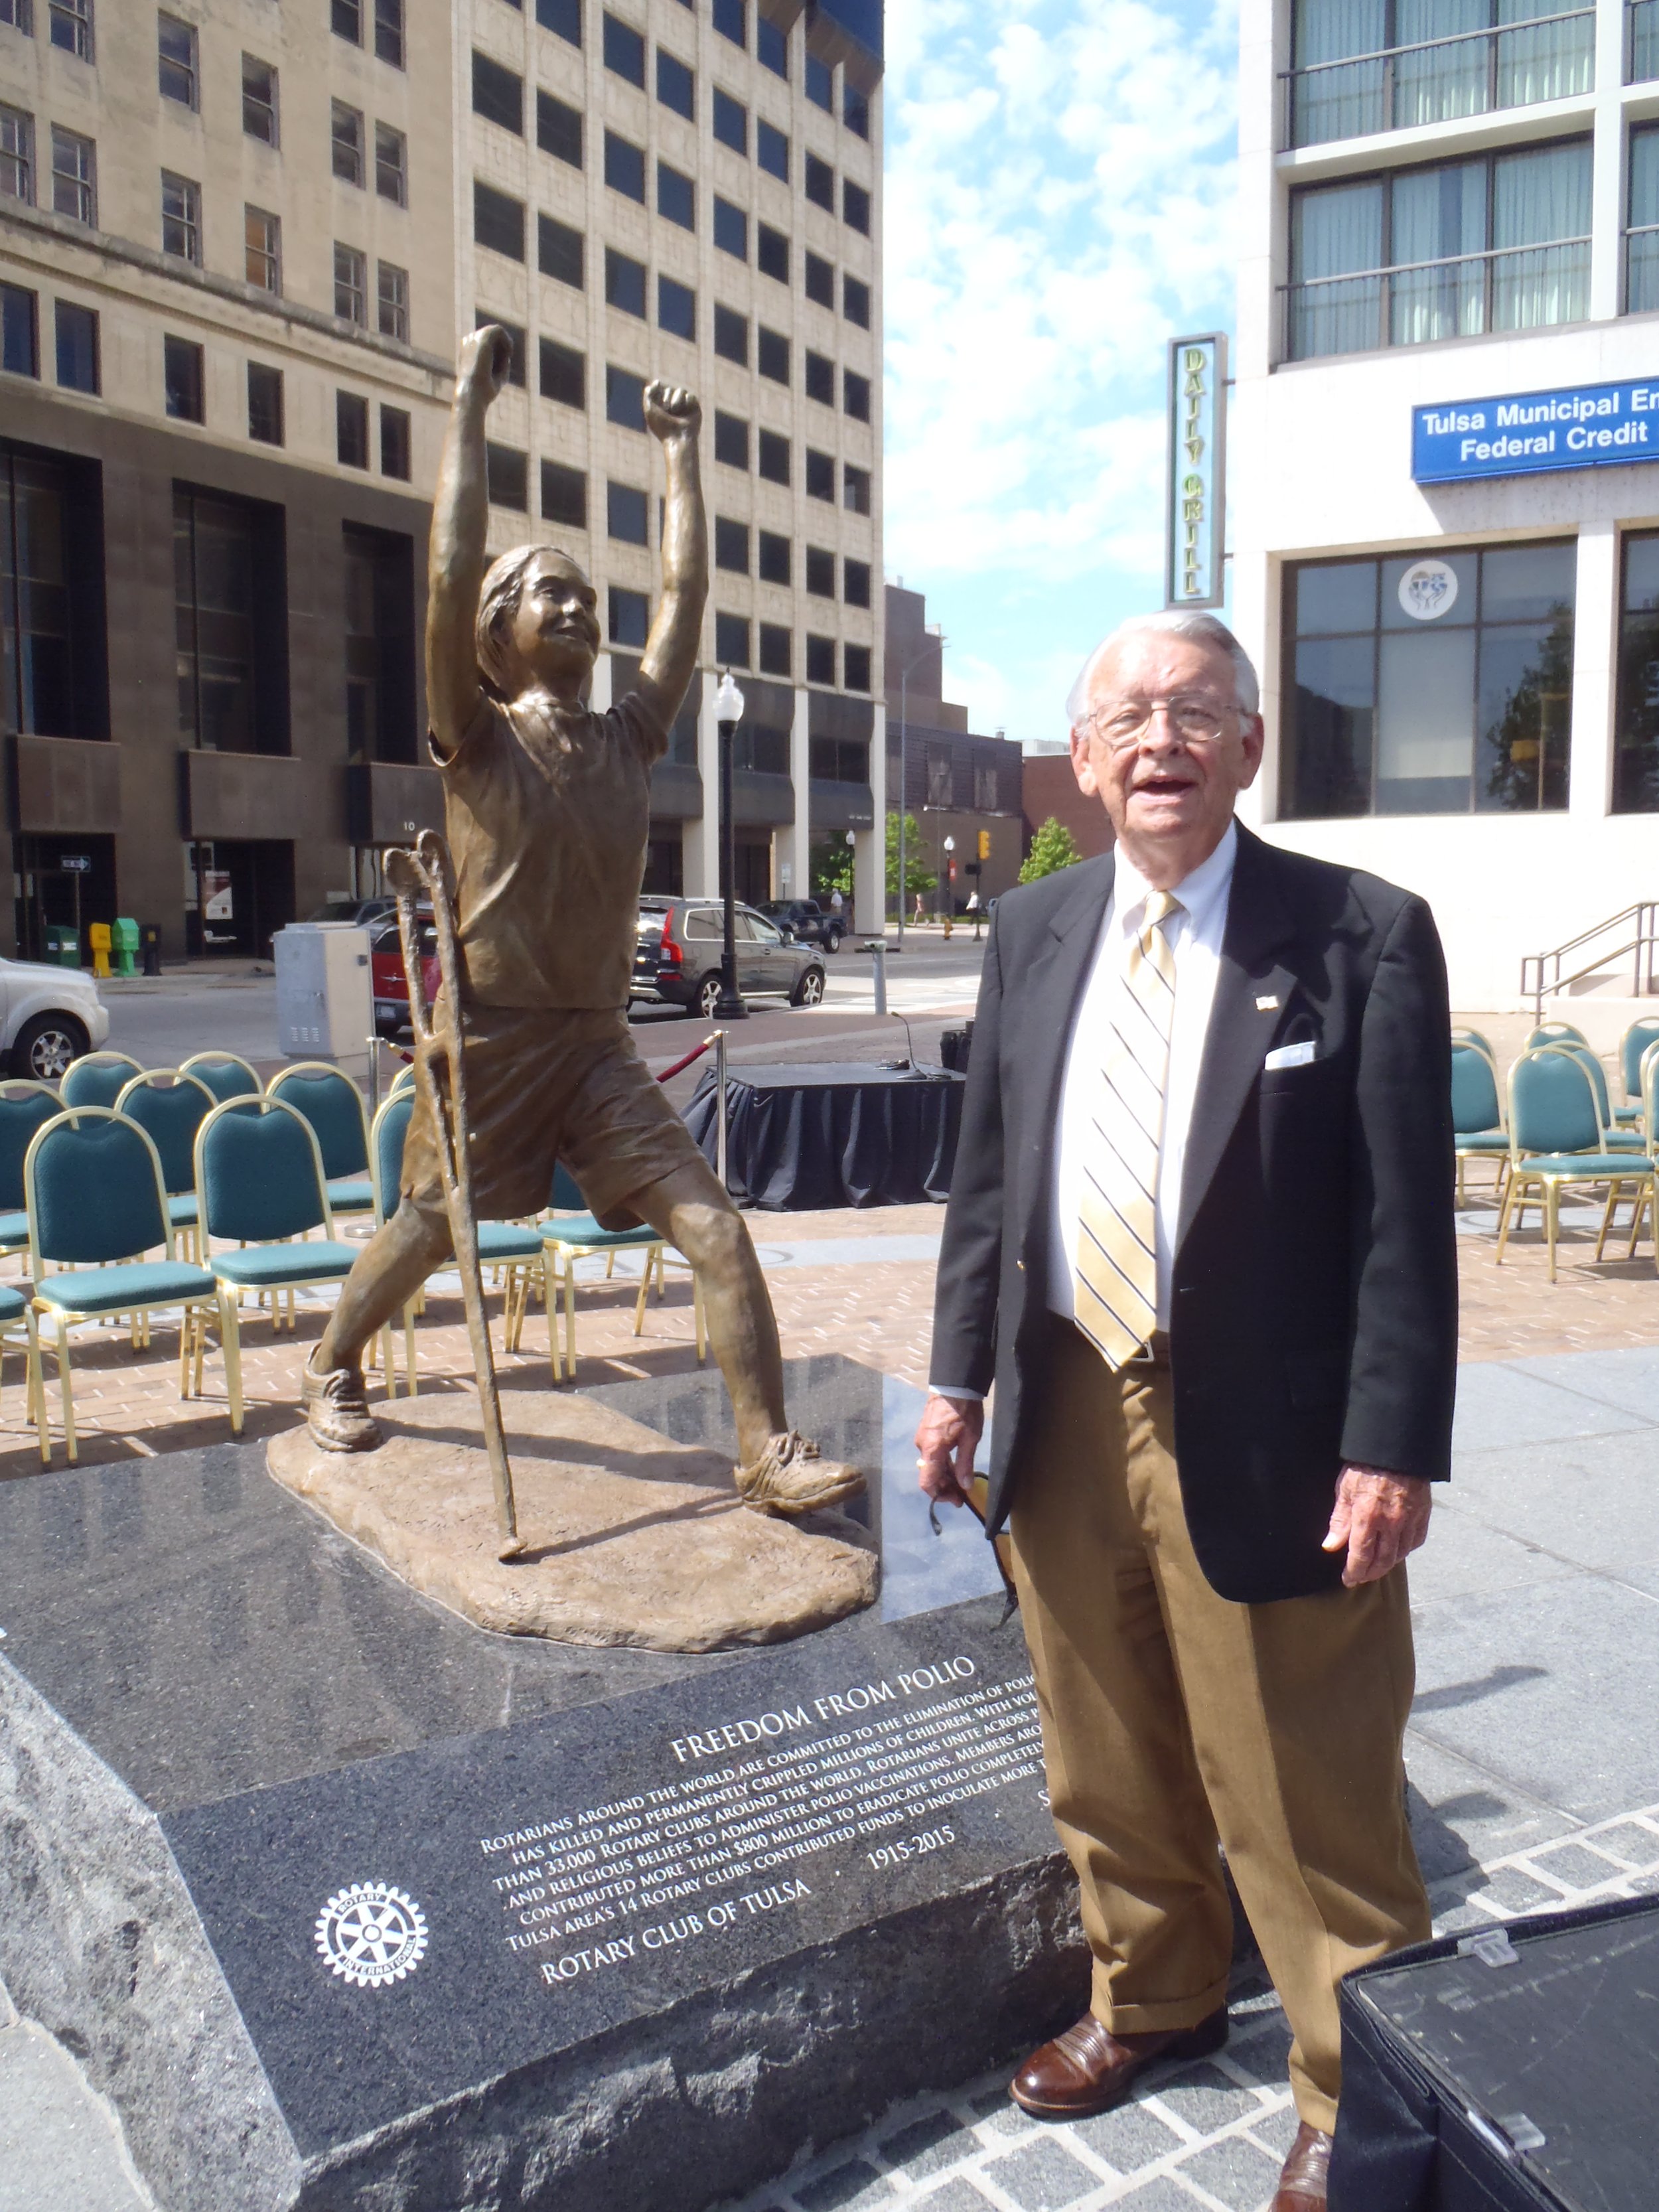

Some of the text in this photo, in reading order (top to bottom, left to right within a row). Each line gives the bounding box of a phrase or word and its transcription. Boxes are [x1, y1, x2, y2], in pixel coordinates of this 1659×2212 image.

[1184, 348, 1206, 465] DAILY
[1422, 411, 1486, 435] Tulsa
[1496, 392, 1619, 427] Municipal
[1461, 421, 1648, 461] Federal Credit
[1183, 473, 1202, 595] GRILL
[480, 1816, 573, 1854] ROTARIANS
[578, 1796, 645, 1826] AROUND
[645, 1785, 679, 1804] THE
[680, 1769, 735, 1794] WORLD
[739, 1759, 766, 1777] ARE
[766, 1733, 851, 1767] COMMITTED
[851, 1726, 873, 1740] TO
[873, 1717, 902, 1733] THE
[902, 1690, 986, 1725] ELIMINATION
[986, 1684, 1003, 1698] OF
[669, 1657, 976, 1763] FREEDOM FROM POLIO
[492, 1866, 542, 1891] THAN
[599, 1829, 661, 1858] ROTARY
[664, 1814, 712, 1838] CLUBS
[715, 1794, 778, 1823] AROUND
[778, 1783, 810, 1801] THE
[866, 1740, 941, 1773] ROTARIANS
[942, 1728, 982, 1747] UNITE
[983, 1712, 1031, 1735] ACROSS
[510, 1887, 545, 1909] AND
[548, 1858, 634, 1895] RELIGIOUS
[636, 1840, 693, 1868] BELIEFS
[693, 1832, 717, 1848] TO
[721, 1803, 811, 1842] ADMINISTER
[810, 1789, 853, 1810] POLIO
[955, 1734, 1015, 1762] MEMBERS
[512, 1845, 545, 1866] HAS
[548, 1828, 603, 1854] KILLED
[608, 1816, 642, 1837] AND
[644, 1782, 749, 1825] PERMANENTLY
[751, 1762, 818, 1791] CRIPPLED
[820, 1741, 885, 1770] MILLIONS
[885, 1733, 903, 1748] OF
[974, 1699, 1013, 1718] WITH
[520, 1879, 636, 1925] CONTRIBUTED
[640, 1862, 685, 1887] MORE
[685, 1847, 732, 1871] THAN
[733, 1834, 768, 1856] $800
[770, 1814, 833, 1844] MILLION
[832, 1807, 855, 1822] TO
[856, 1783, 929, 1814] ERADICATE
[929, 1768, 970, 1790] POLIO
[337, 1893, 382, 1913] ROTARY
[504, 1925, 561, 1951] TULSA
[618, 1897, 638, 1915] 14
[640, 1877, 701, 1908] ROTARY
[705, 1861, 752, 1885] CLUBS
[754, 1826, 855, 1870] CONTRIBUTED
[857, 1808, 904, 1834] FUNDS
[904, 1802, 926, 1817] TO
[925, 1775, 1000, 1810] INOCULATE
[1000, 1762, 1038, 1784] MORE
[540, 1935, 636, 1985] ROTARY
[642, 1915, 703, 1949] CLUB
[707, 1901, 737, 1927] OF
[739, 1878, 812, 1914] TULSA
[866, 1824, 956, 1870] 1915-2015
[342, 1937, 417, 1975] INTERNATIONAL
